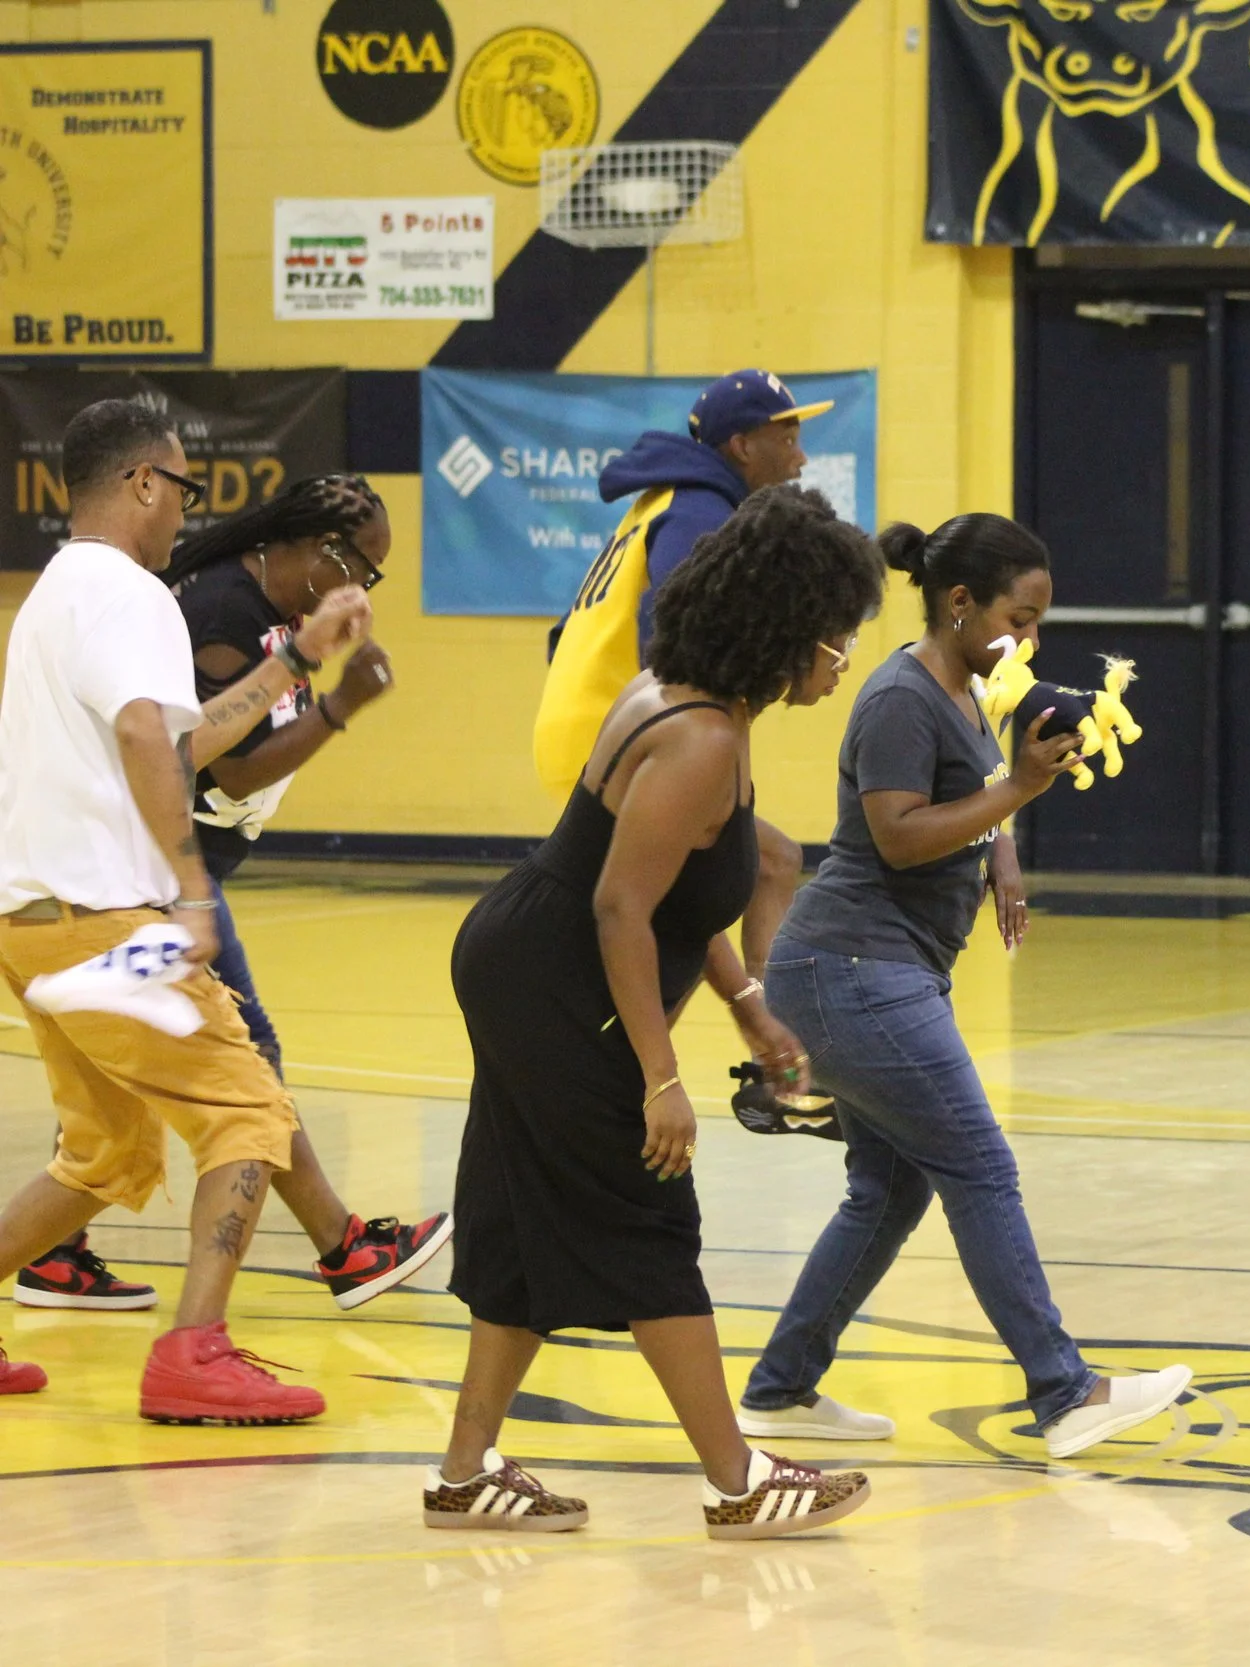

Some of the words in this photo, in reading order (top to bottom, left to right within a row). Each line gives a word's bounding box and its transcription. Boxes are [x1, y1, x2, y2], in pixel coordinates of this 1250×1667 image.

[323, 33, 449, 75] NCAA
[404, 212, 485, 233] Points
[286, 272, 365, 288] PIZZA
